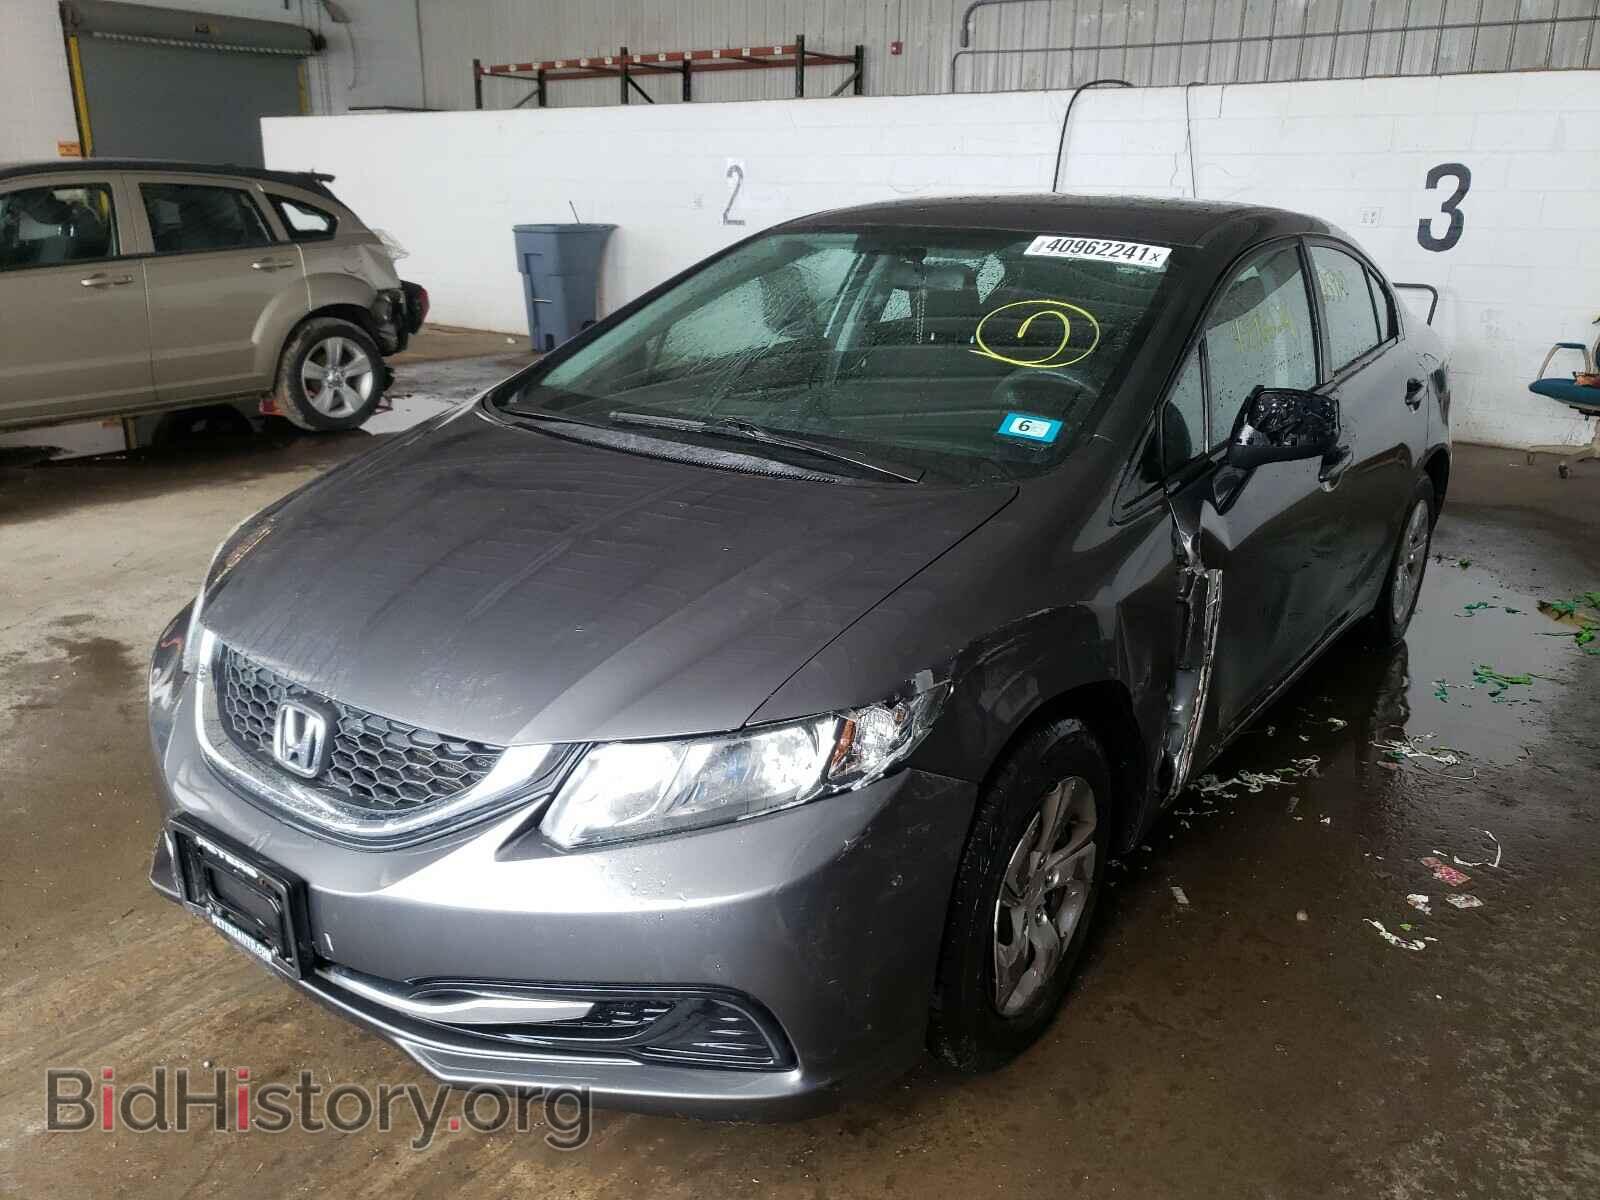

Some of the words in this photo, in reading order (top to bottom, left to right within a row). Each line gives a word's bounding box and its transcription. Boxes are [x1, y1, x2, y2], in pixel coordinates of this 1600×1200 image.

[722, 164, 745, 226] 2
[1417, 162, 1472, 253] 3
[1045, 237, 1150, 262] 40962241
[1018, 419, 1033, 432] 6
